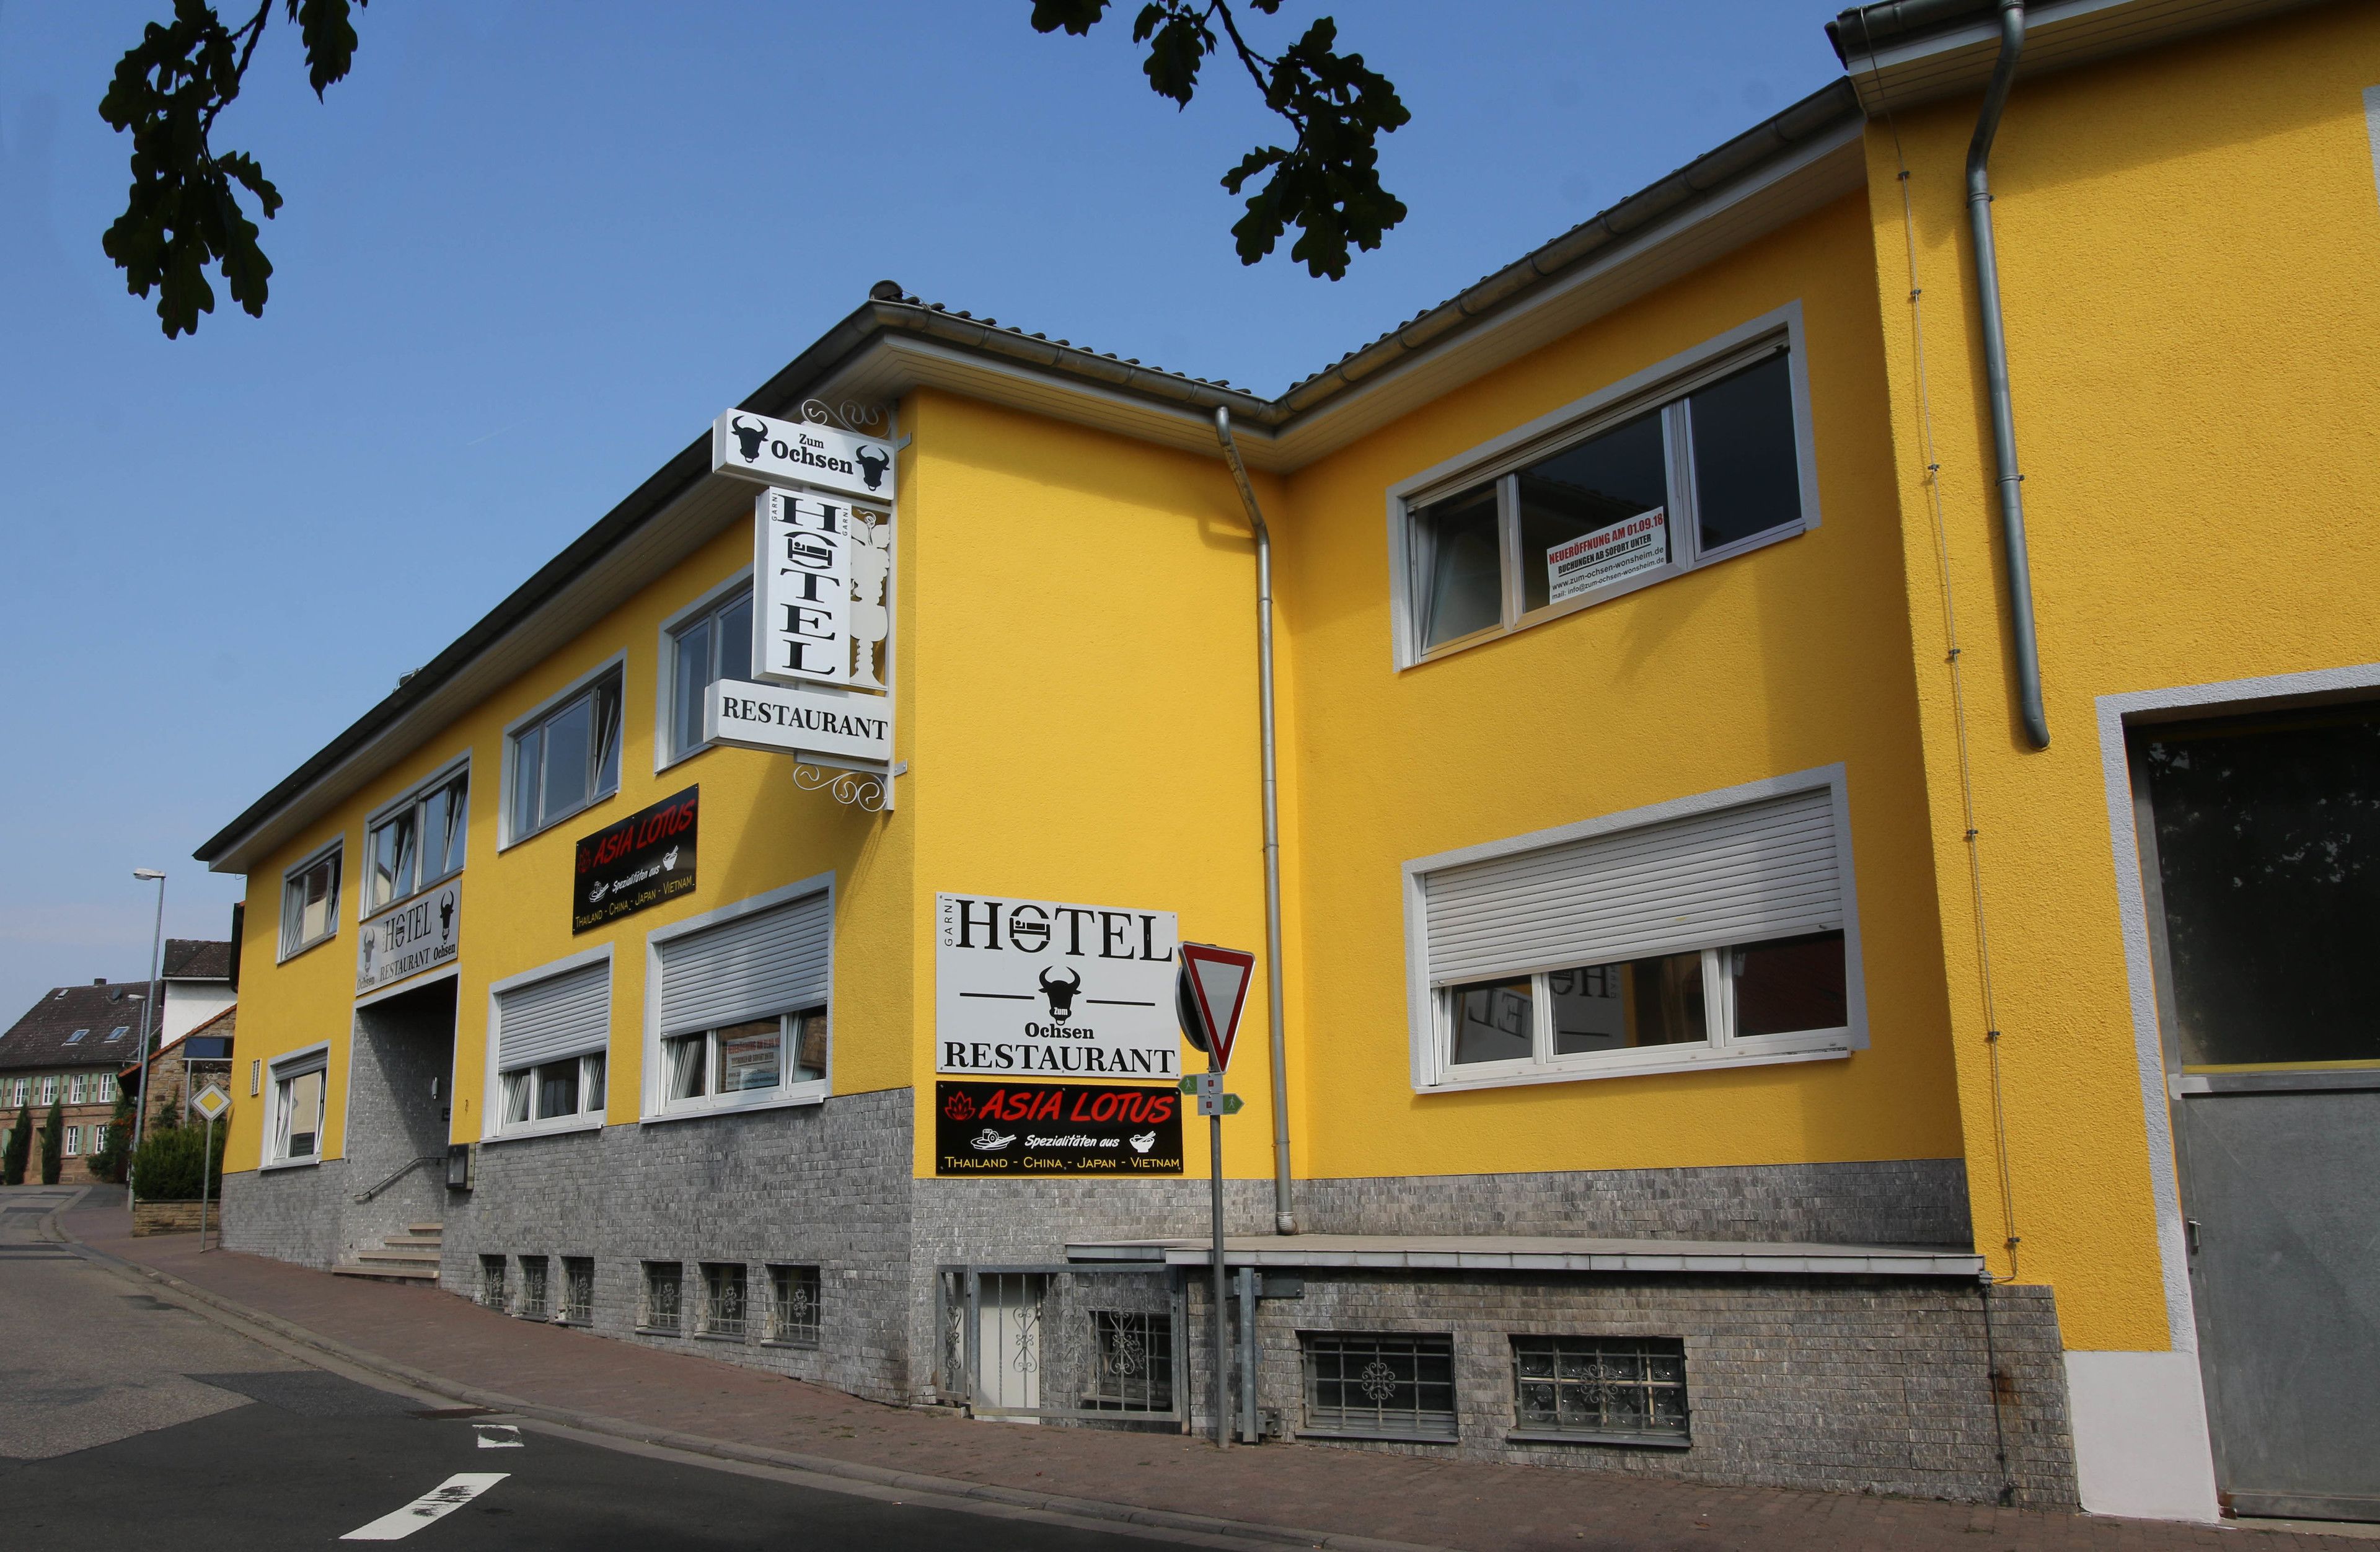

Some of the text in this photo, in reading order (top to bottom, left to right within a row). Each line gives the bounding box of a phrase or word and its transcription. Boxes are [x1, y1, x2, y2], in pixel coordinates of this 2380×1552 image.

[771, 440, 853, 475] Ochsen
[800, 433, 824, 449] Zum
[1549, 513, 1664, 565] NEUERÖFFNUNG AM 01.09.18
[1558, 534, 1651, 574] BUCHUNGEN AB SOFORT UNTER
[778, 494, 840, 676] HOTEL
[1552, 546, 1664, 591] www.zum-ochsen-wonsheim.de
[1552, 557, 1664, 600] mail: info@zum-ochsen-wonsheim.de
[722, 697, 888, 741] RESTAURANT
[593, 798, 695, 867] ASIA LOTUS
[609, 899, 628, 915] CHINA
[635, 889, 656, 906] JAPAN
[663, 875, 692, 894] VIETNAM
[612, 865, 660, 894] Spezialitäten aus
[384, 901, 431, 953] HOTEL
[945, 898, 953, 946] GARNI
[956, 899, 1173, 962] HOTEL
[380, 947, 431, 982] RESTAURANT
[434, 943, 456, 960] Ochsen
[1054, 1007, 1068, 1015] Zum
[1025, 1022, 1095, 1039] Ochsen
[944, 1041, 1175, 1074] RESTAURANT
[978, 1089, 1173, 1123] ASIA LOTUS
[1025, 1134, 1120, 1149] Spezialitäten aus
[945, 1157, 1008, 1168] THAILAND
[1077, 1157, 1116, 1168] JAPAN
[1130, 1157, 1179, 1168] VIETNAM
